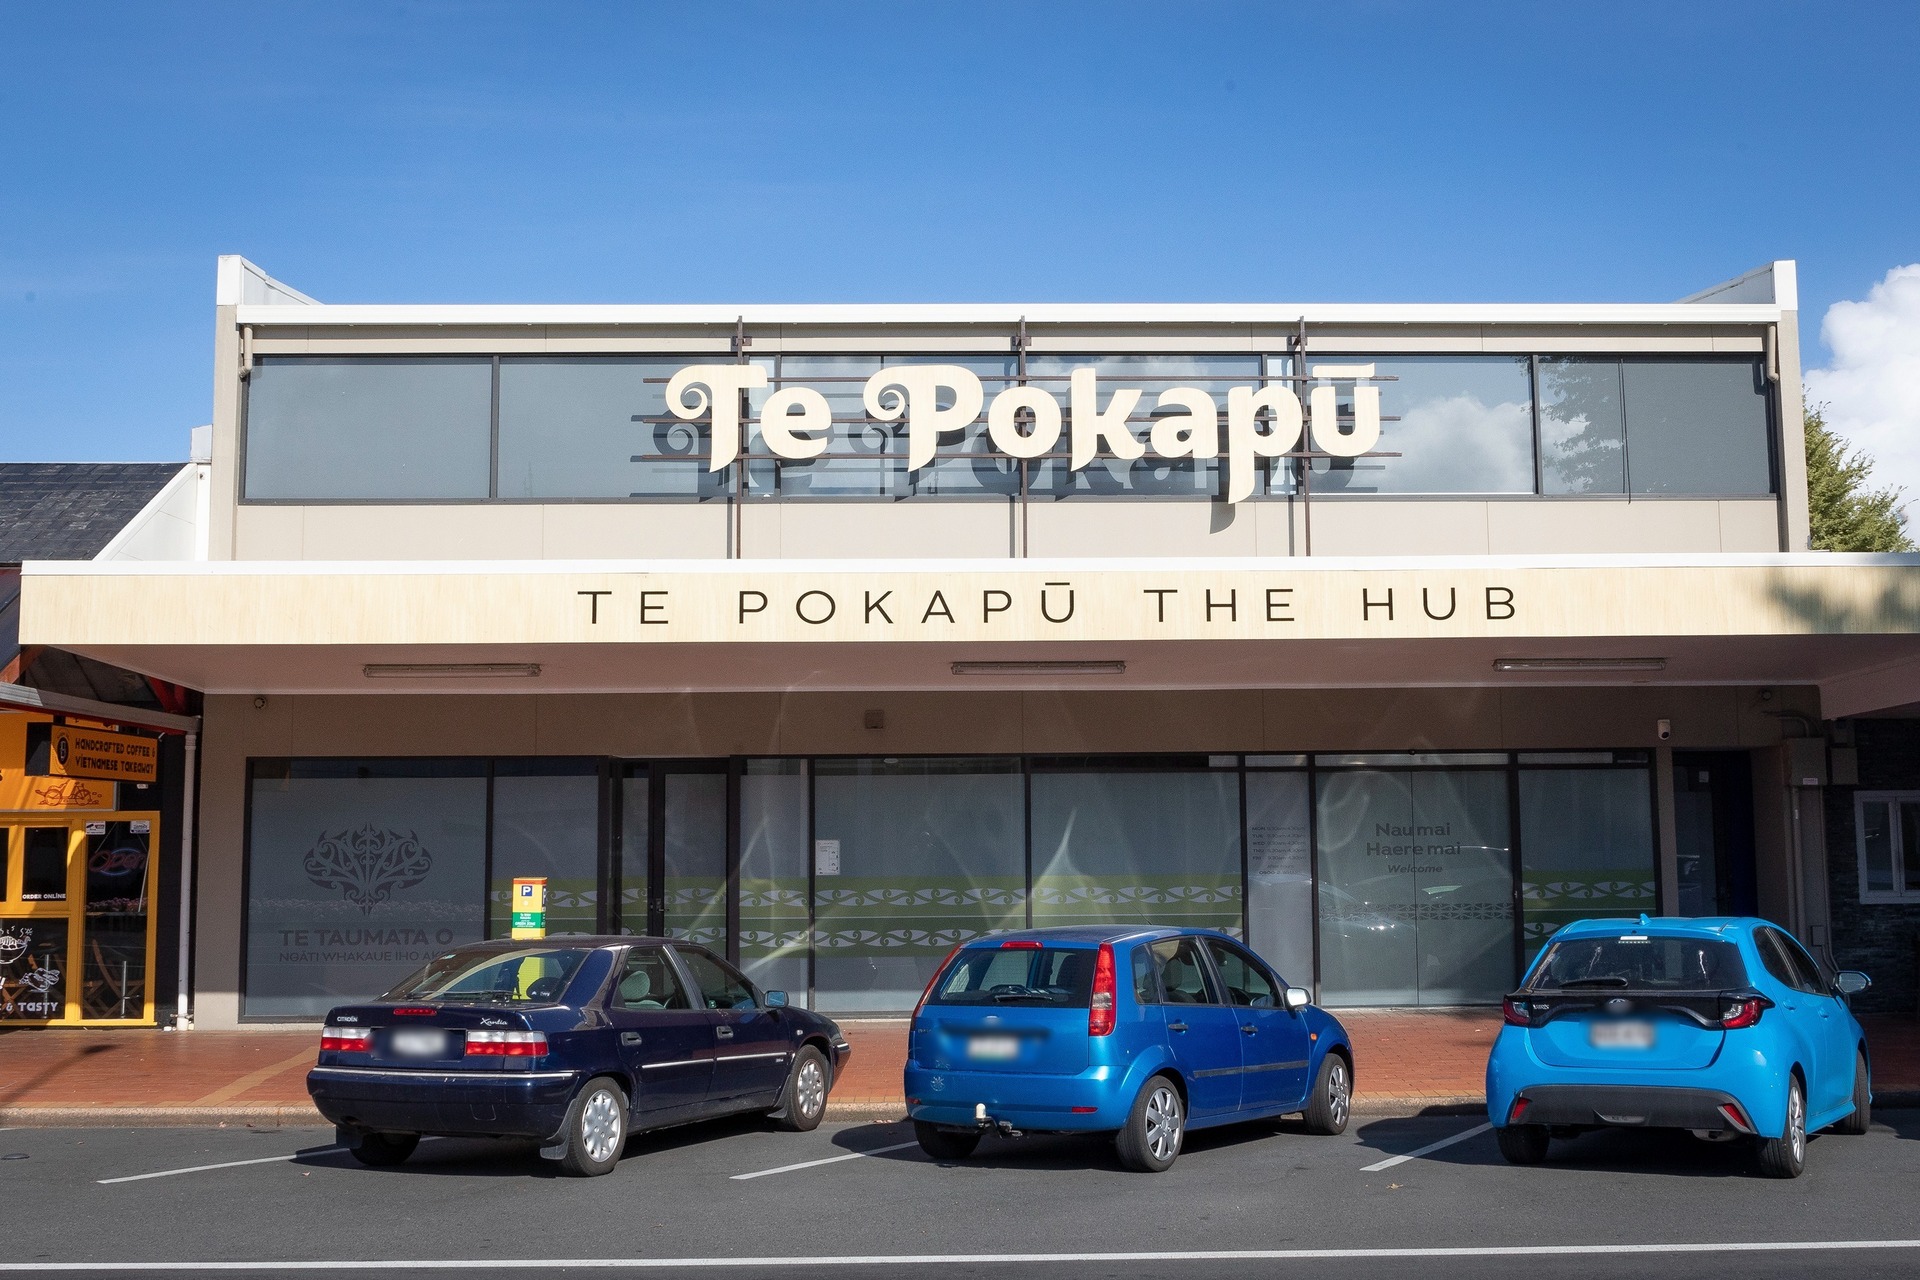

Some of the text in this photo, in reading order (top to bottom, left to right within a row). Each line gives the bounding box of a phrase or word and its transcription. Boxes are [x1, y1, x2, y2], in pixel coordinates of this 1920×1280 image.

[665, 362, 1381, 504] Te Pokapū
[577, 581, 1516, 624] TE POKAPŪ THE HUB
[126, 744, 151, 758] COFFEE
[1375, 822, 1451, 836] Nau mai
[1366, 841, 1461, 856] Haere mai
[1387, 864, 1443, 873] Welcome
[522, 886, 532, 896] P
[278, 928, 454, 947] TE TAUMATA O
[323, 951, 392, 962] WHAKAUE
[395, 951, 419, 961] IHO
[480, 1016, 508, 1026] Xantia
